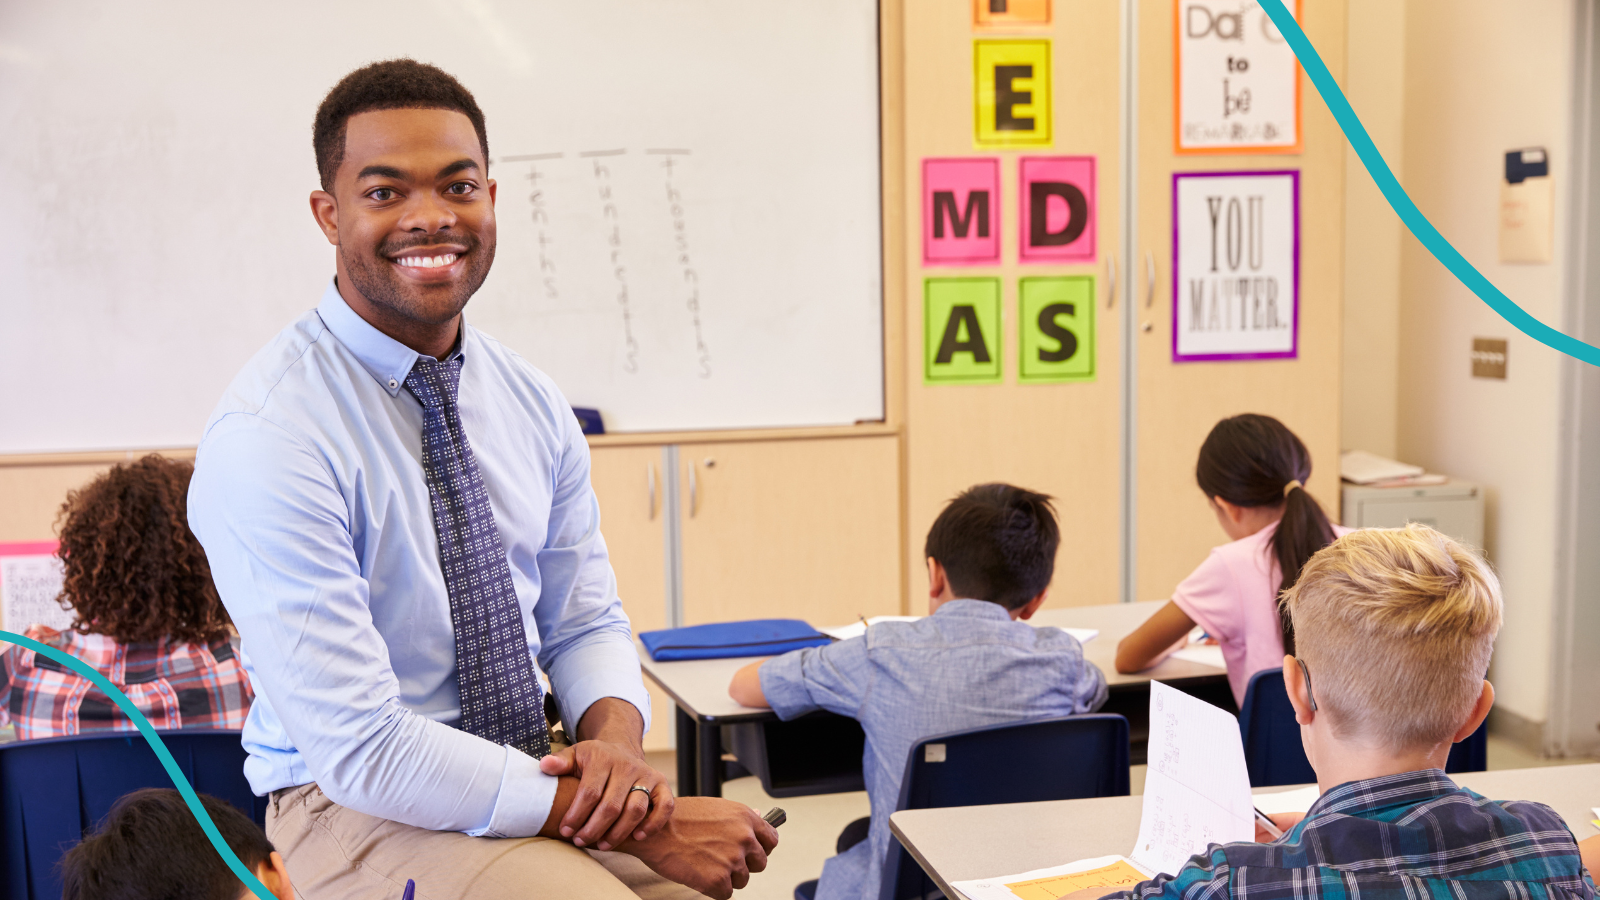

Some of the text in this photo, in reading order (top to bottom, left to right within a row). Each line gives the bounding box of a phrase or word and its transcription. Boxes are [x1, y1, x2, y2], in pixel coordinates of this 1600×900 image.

[1227, 56, 1249, 73] to
[995, 65, 1034, 130] E
[1223, 78, 1252, 118] be
[524, 164, 559, 299] tenths
[933, 181, 1087, 247] M D
[1207, 196, 1264, 272] YOU
[934, 303, 1078, 364] A S
[1189, 276, 1287, 331] MATTER.
